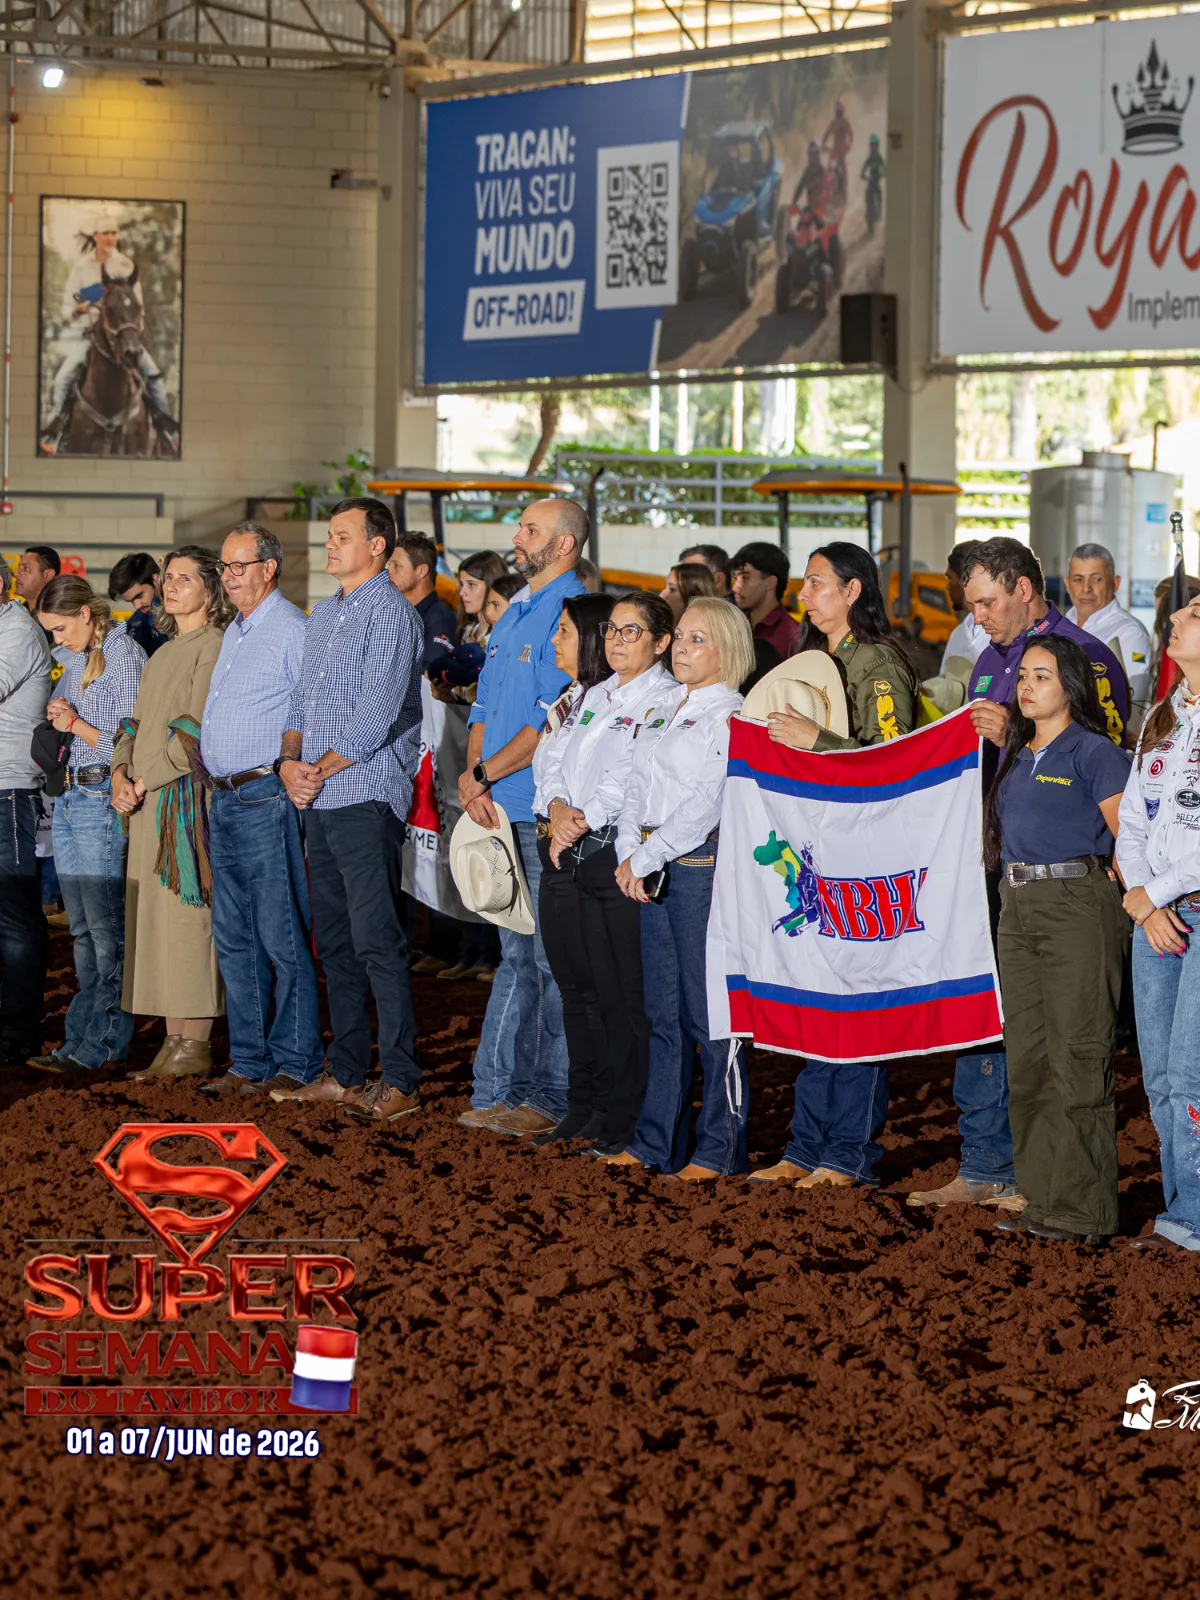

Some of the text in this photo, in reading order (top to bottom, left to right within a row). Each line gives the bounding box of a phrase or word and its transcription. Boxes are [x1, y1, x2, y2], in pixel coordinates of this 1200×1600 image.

[475, 125, 575, 173] TRACAN:
[475, 171, 576, 220] VIVA SEU
[475, 219, 575, 276] MUNDO
[473, 290, 574, 330] OFF-ROAD!
